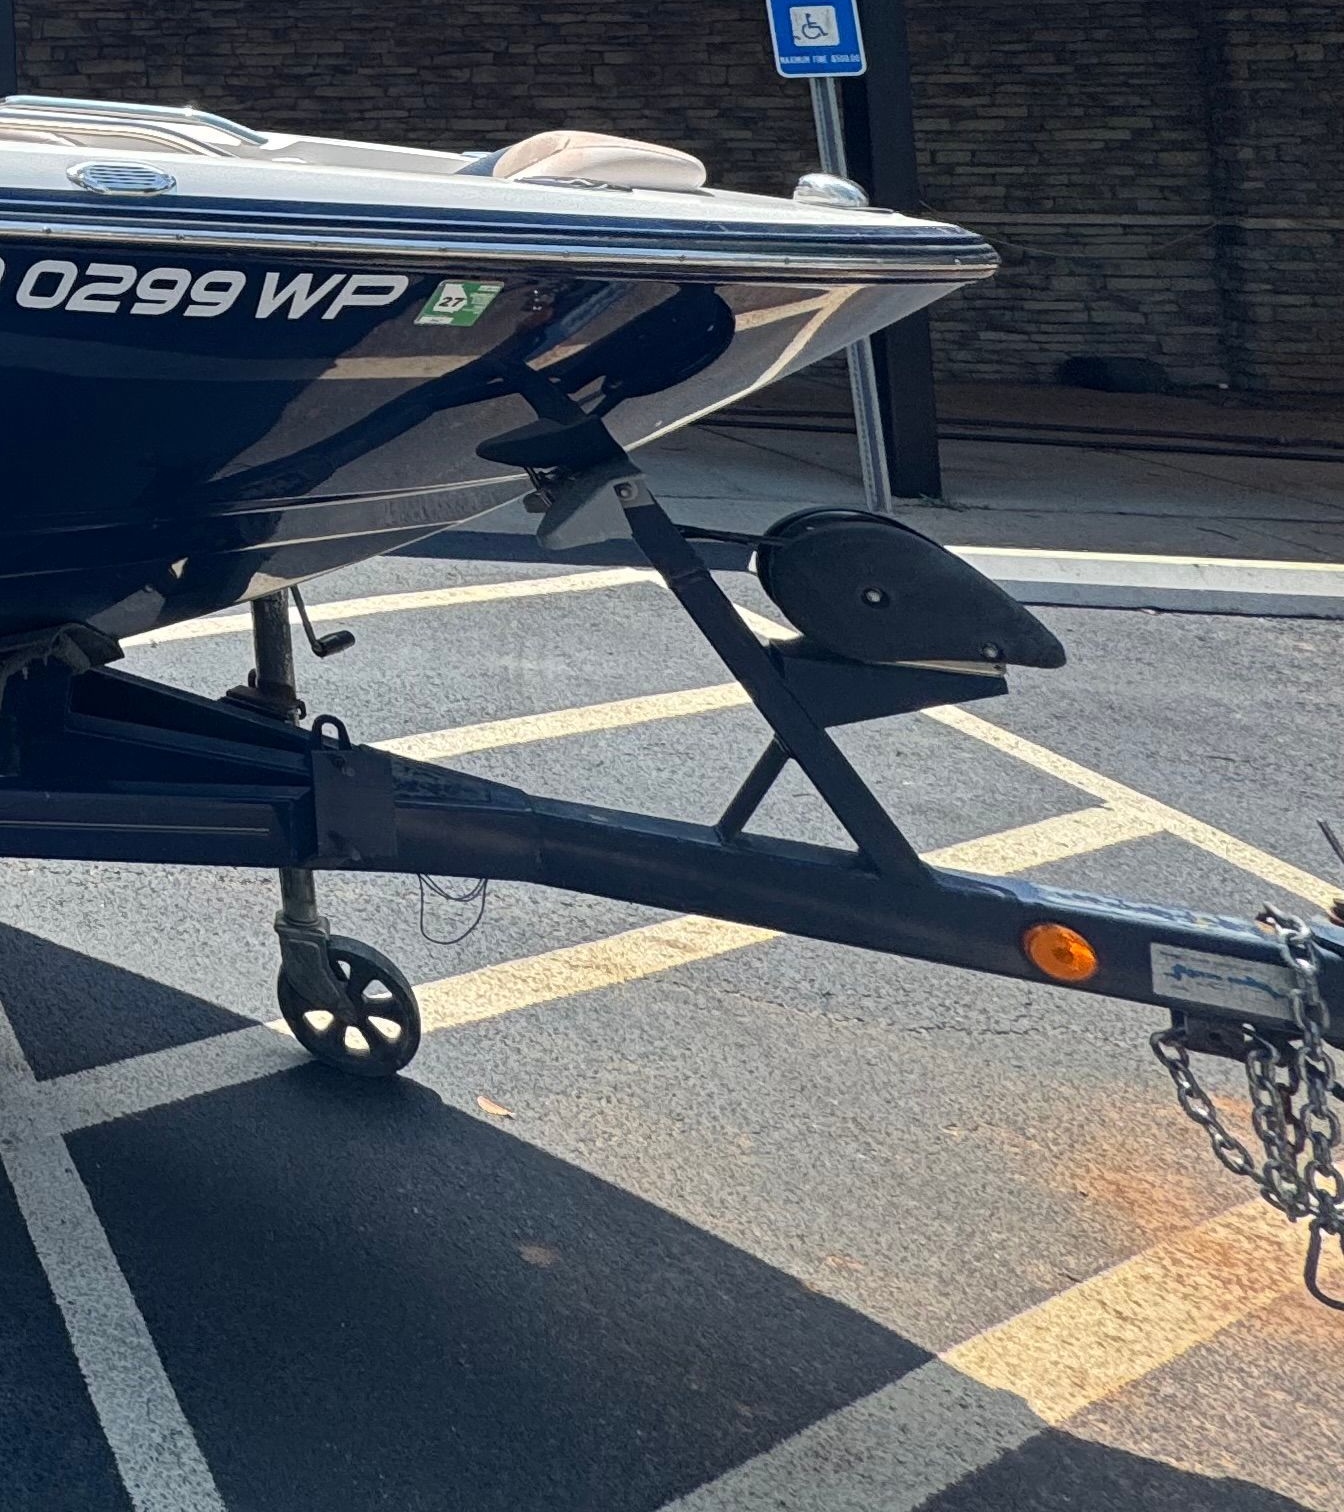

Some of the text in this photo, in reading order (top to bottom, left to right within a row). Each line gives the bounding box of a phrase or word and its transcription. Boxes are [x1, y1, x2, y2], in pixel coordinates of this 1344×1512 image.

[16, 259, 246, 318] 0299
[253, 272, 409, 321] WP
[438, 296, 465, 308] 27
